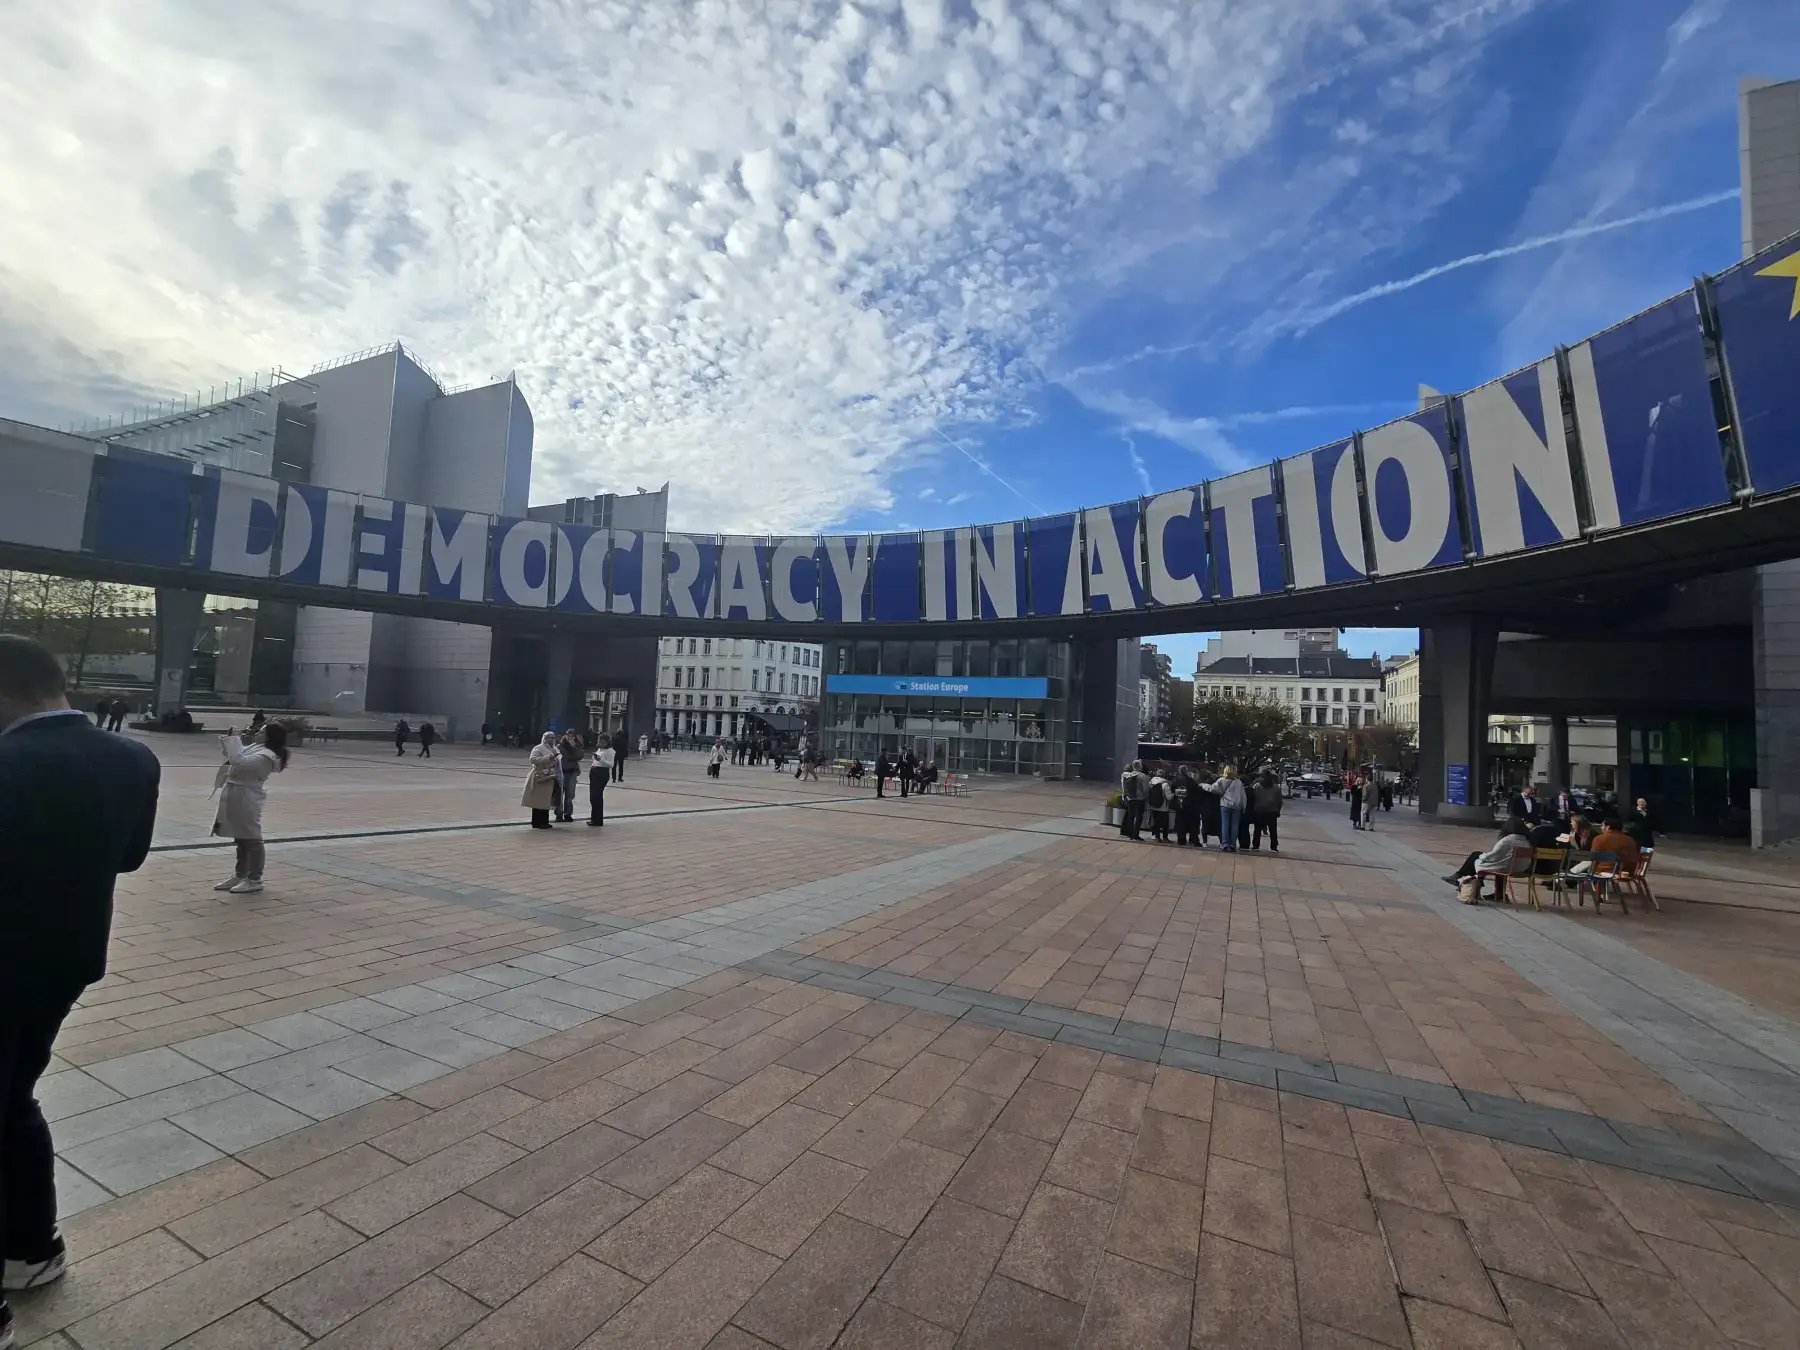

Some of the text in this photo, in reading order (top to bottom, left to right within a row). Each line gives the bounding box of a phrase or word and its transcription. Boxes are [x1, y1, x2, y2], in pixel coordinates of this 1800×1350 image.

[210, 341, 1621, 623] DEMOCRACY IN ACTION
[910, 681, 969, 693] Station Europe
